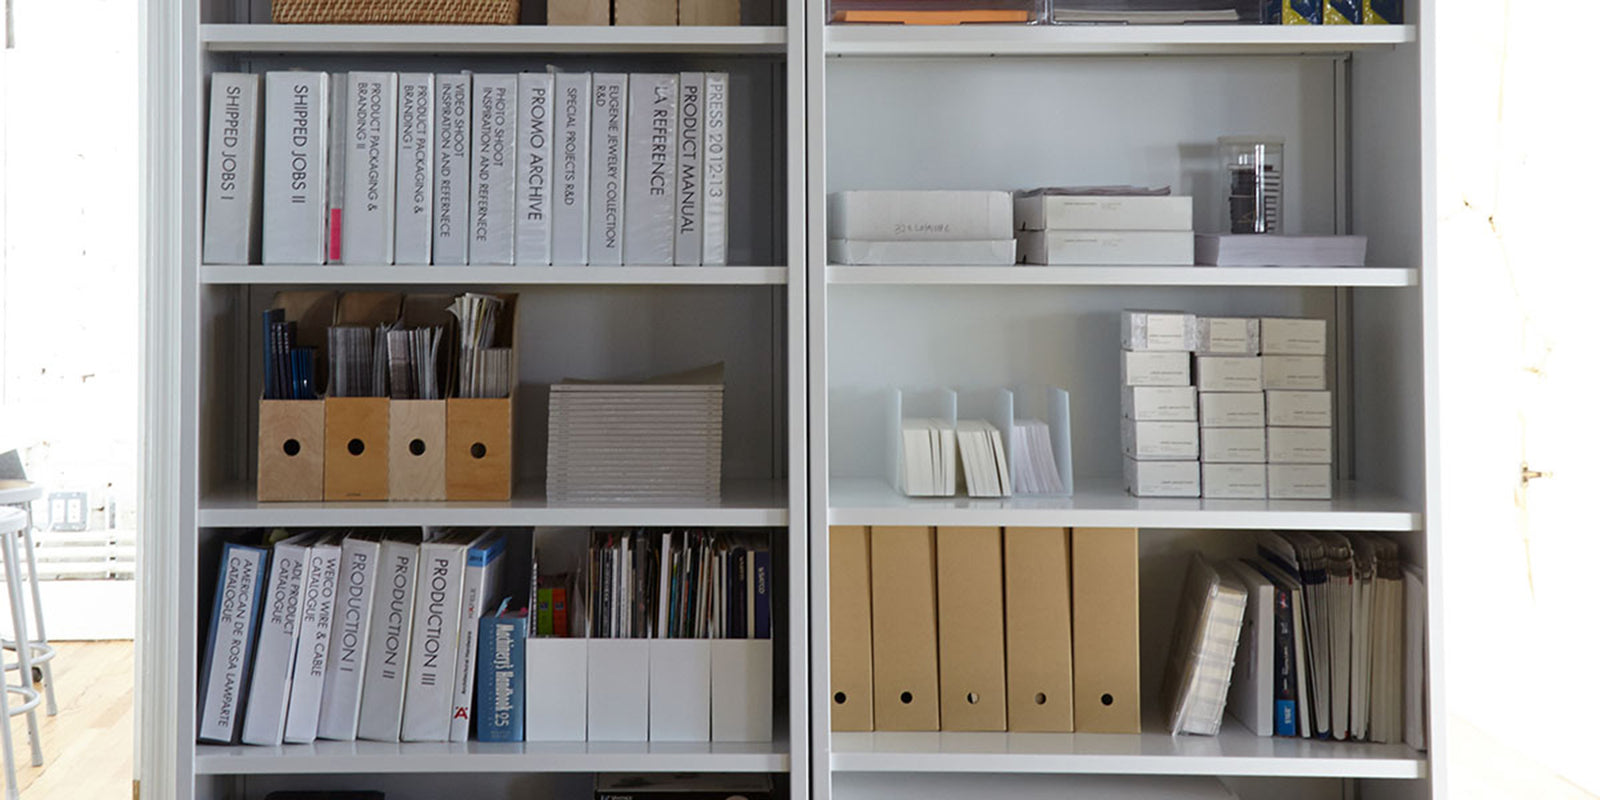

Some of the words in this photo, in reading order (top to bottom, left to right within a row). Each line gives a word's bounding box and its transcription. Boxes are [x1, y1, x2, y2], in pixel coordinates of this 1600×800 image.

[224, 86, 240, 148] SHIPPED
[293, 85, 308, 147] SHIPPED
[356, 83, 367, 141] BRANDING
[370, 83, 381, 132] PRODUCT
[403, 85, 414, 143] BRANDING
[416, 86, 427, 135] PRODUCT
[441, 84, 451, 148] INSPIRATION
[455, 84, 465, 115] VIDEO
[480, 87, 493, 152] INSPIRATION
[494, 87, 506, 126] PHOTO
[530, 88, 546, 149] PROMO
[566, 87, 577, 128] SPECIAL
[596, 85, 605, 107] R&D
[608, 85, 620, 131] EUGENIE
[709, 84, 723, 128] PRESS
[454, 118, 465, 158] SHOOT
[682, 85, 698, 159] PRODUCT
[221, 153, 237, 190] JOBS
[292, 152, 306, 190] JOBS
[368, 136, 380, 202] PACKAGING
[414, 138, 426, 204] PACKAGING
[441, 152, 450, 177] AND
[479, 155, 490, 180] AND
[493, 128, 504, 167] SHOOT
[565, 130, 576, 181] PROJECTS
[607, 133, 618, 179] JEWELRY
[650, 109, 668, 195] REFERENCE
[708, 134, 723, 198] 2012-13
[292, 194, 306, 203] II
[528, 153, 544, 220] ARCHIVE
[565, 184, 574, 205] R&D
[680, 164, 696, 234] MANUAL
[605, 181, 618, 248] COLLECTION
[221, 556, 240, 624] CATALOGUE
[236, 558, 252, 619] AMERICAN
[271, 558, 290, 624] CATALOGUE
[283, 584, 300, 636] PRODUCT
[305, 556, 322, 622] CATALOGUE
[341, 553, 366, 665] PRODUCTION
[384, 556, 409, 666] PRODUCTION
[423, 558, 448, 668] PRODUCTION
[232, 622, 244, 636] DE
[316, 632, 326, 640] &
[318, 601, 330, 630] WIRE
[228, 639, 242, 670] ROSA
[310, 643, 325, 676] CABLE
[382, 670, 395, 679] II
[421, 673, 436, 686] III
[218, 673, 236, 728] LAMPARTE
[495, 712, 510, 727] 25
